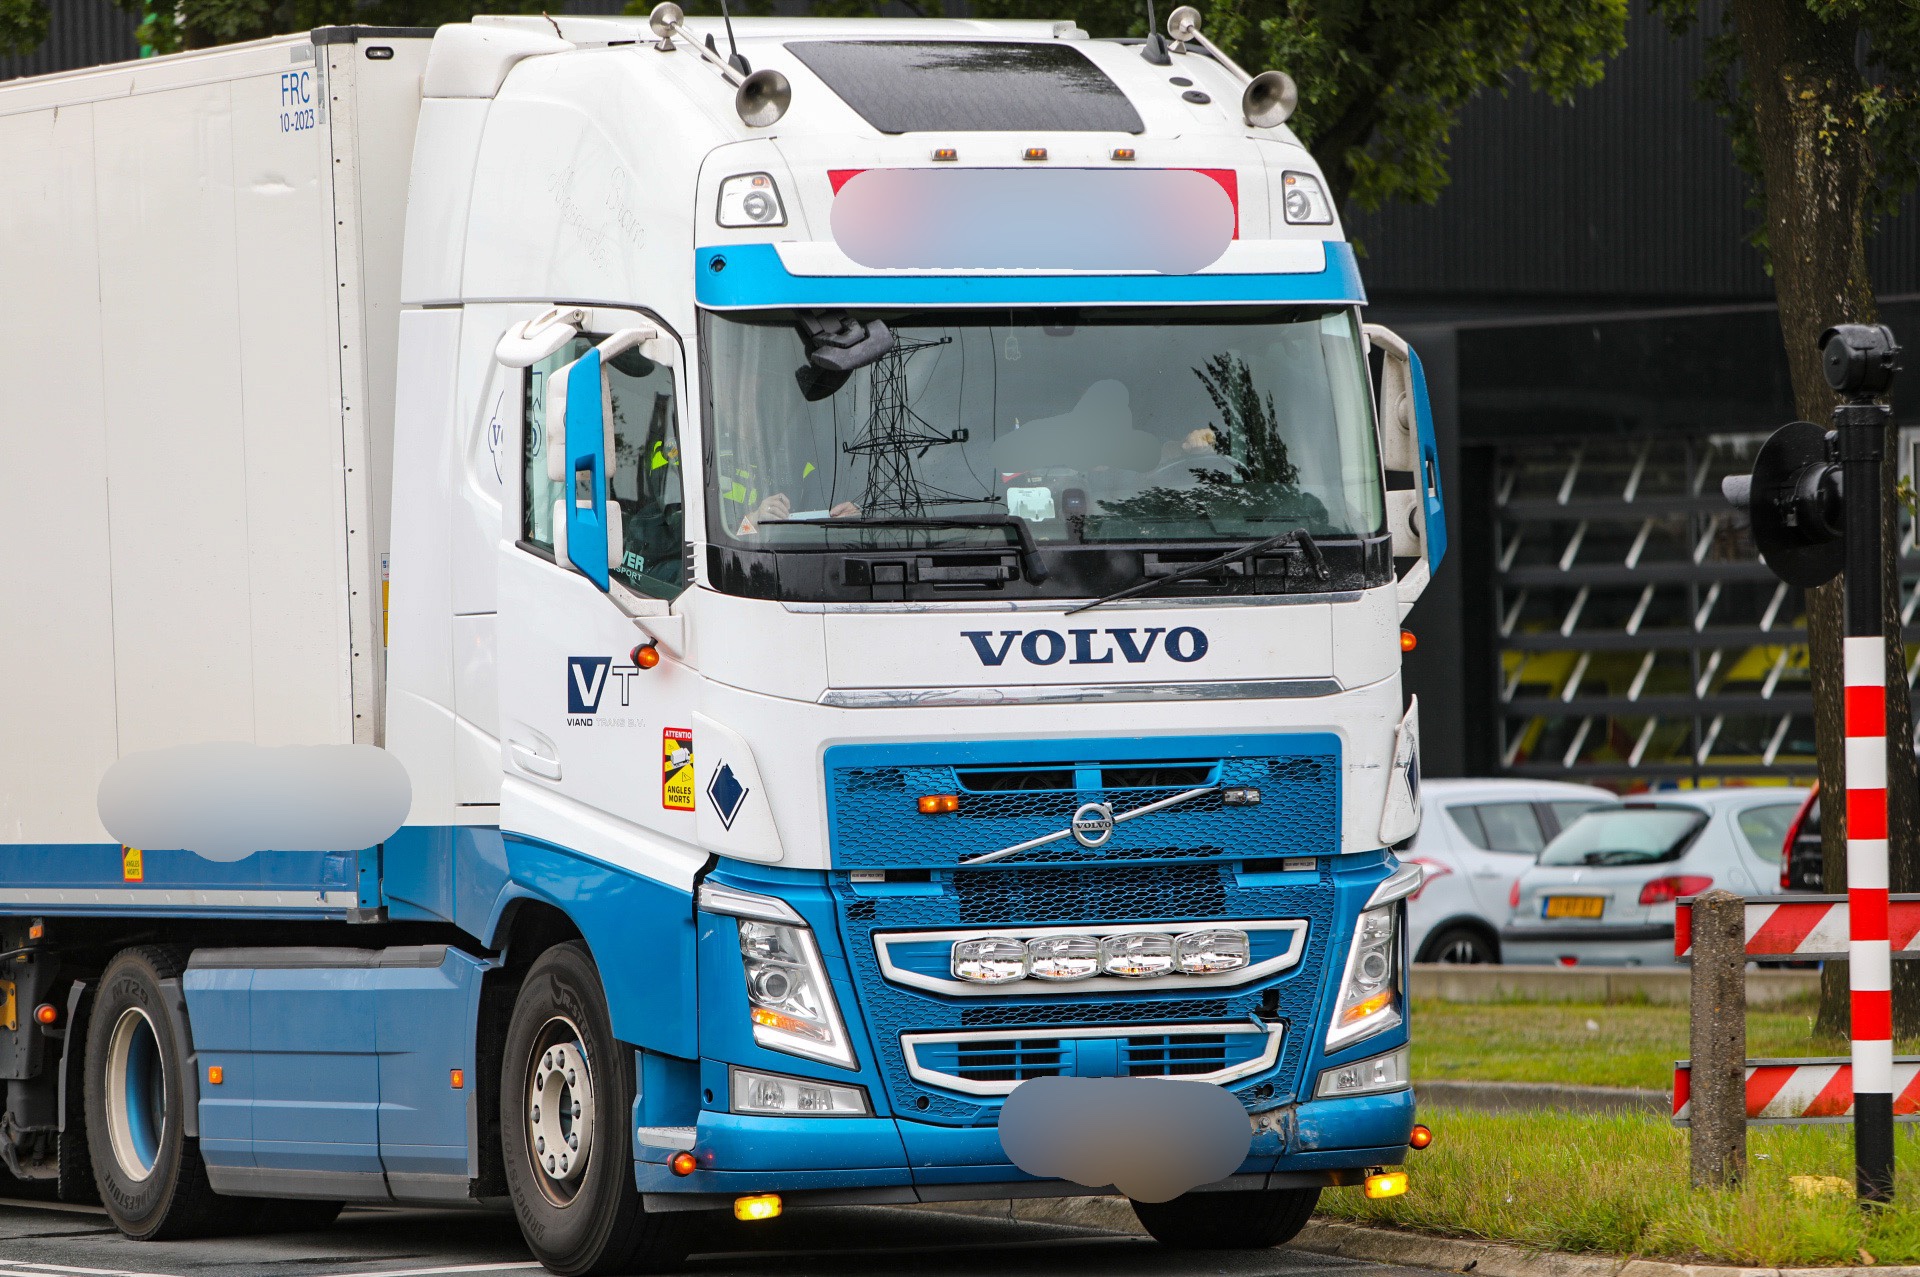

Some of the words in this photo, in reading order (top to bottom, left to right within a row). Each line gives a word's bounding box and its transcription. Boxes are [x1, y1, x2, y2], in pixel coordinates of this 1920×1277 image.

[281, 71, 310, 107] FRC
[280, 108, 315, 133] 10-2023
[613, 566, 643, 581] SPORT
[960, 626, 1209, 667] VOLVO
[567, 718, 593, 727] VIAND
[664, 729, 693, 740] ATTENTIO
[667, 785, 692, 795] ANGLES
[668, 794, 691, 804] MORTS
[1076, 821, 1111, 829] VOLVO
